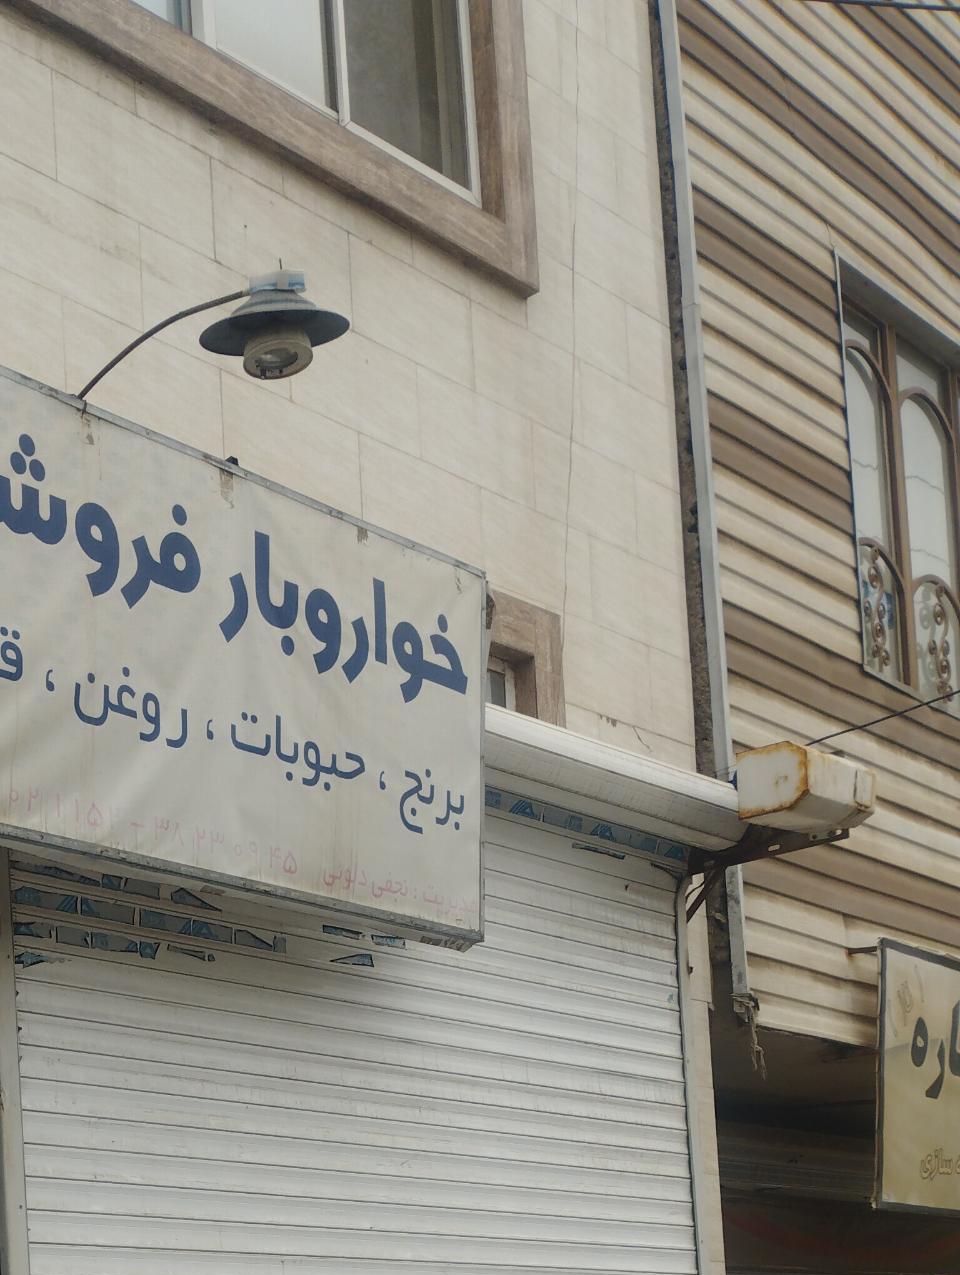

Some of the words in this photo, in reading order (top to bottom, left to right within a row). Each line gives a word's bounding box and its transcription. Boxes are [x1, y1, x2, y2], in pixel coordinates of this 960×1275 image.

[219, 531, 469, 703] خواروبار
[74, 665, 188, 749] روغن
[230, 711, 366, 791] حبوبات
[398, 767, 465, 835] برنج
